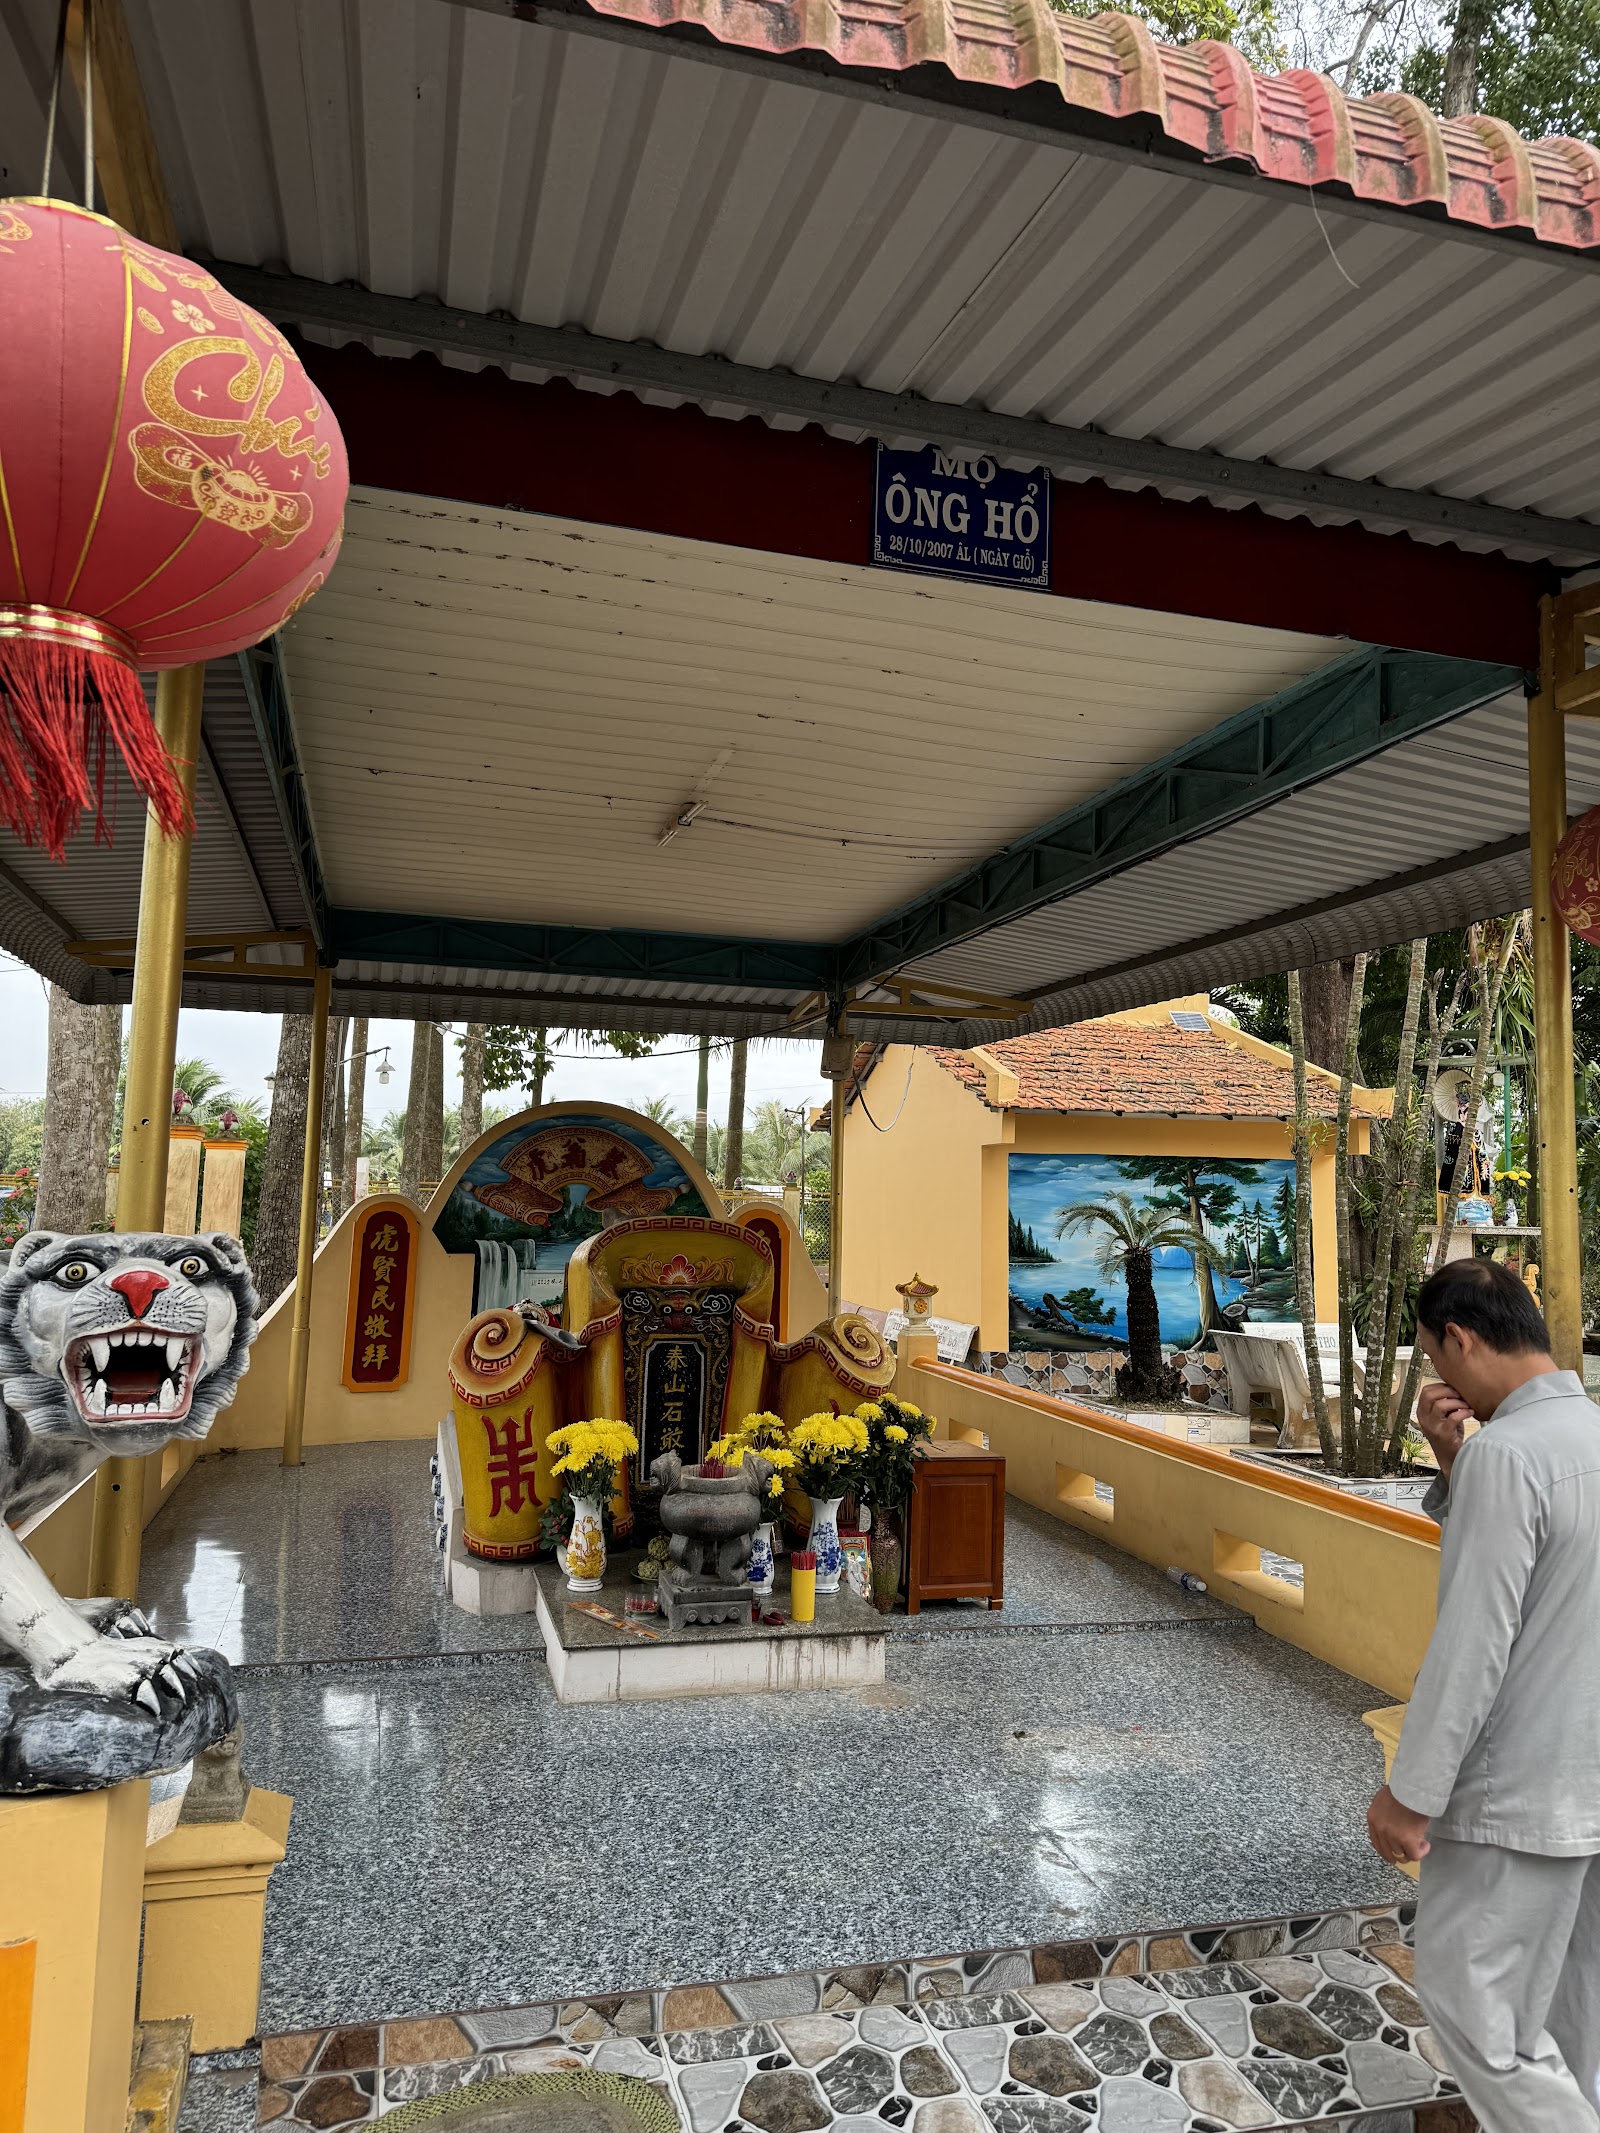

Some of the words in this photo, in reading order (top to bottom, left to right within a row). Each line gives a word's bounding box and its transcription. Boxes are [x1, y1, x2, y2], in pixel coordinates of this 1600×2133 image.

[885, 472, 970, 534] ÔNG
[984, 483, 1040, 544] HỔ
[890, 535, 953, 558] 28/10/2007
